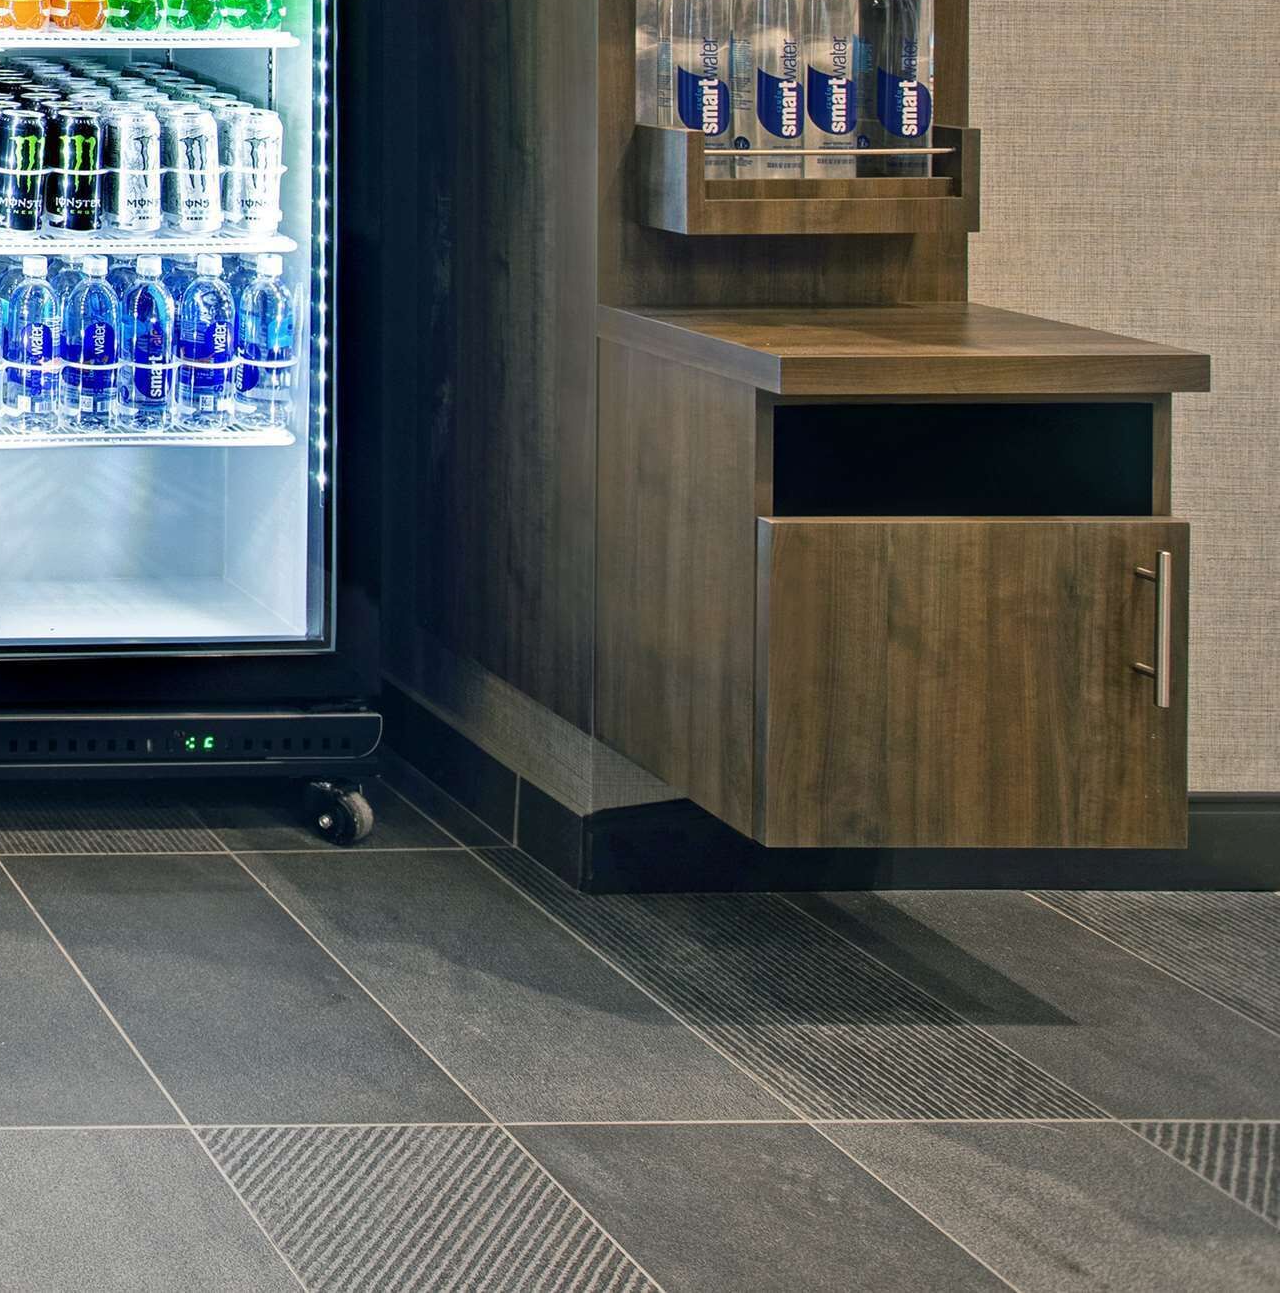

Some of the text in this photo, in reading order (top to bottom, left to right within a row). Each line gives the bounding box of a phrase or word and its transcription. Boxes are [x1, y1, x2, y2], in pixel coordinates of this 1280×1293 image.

[31, 324, 44, 356] water
[94, 323, 106, 355] water
[212, 322, 227, 354] water
